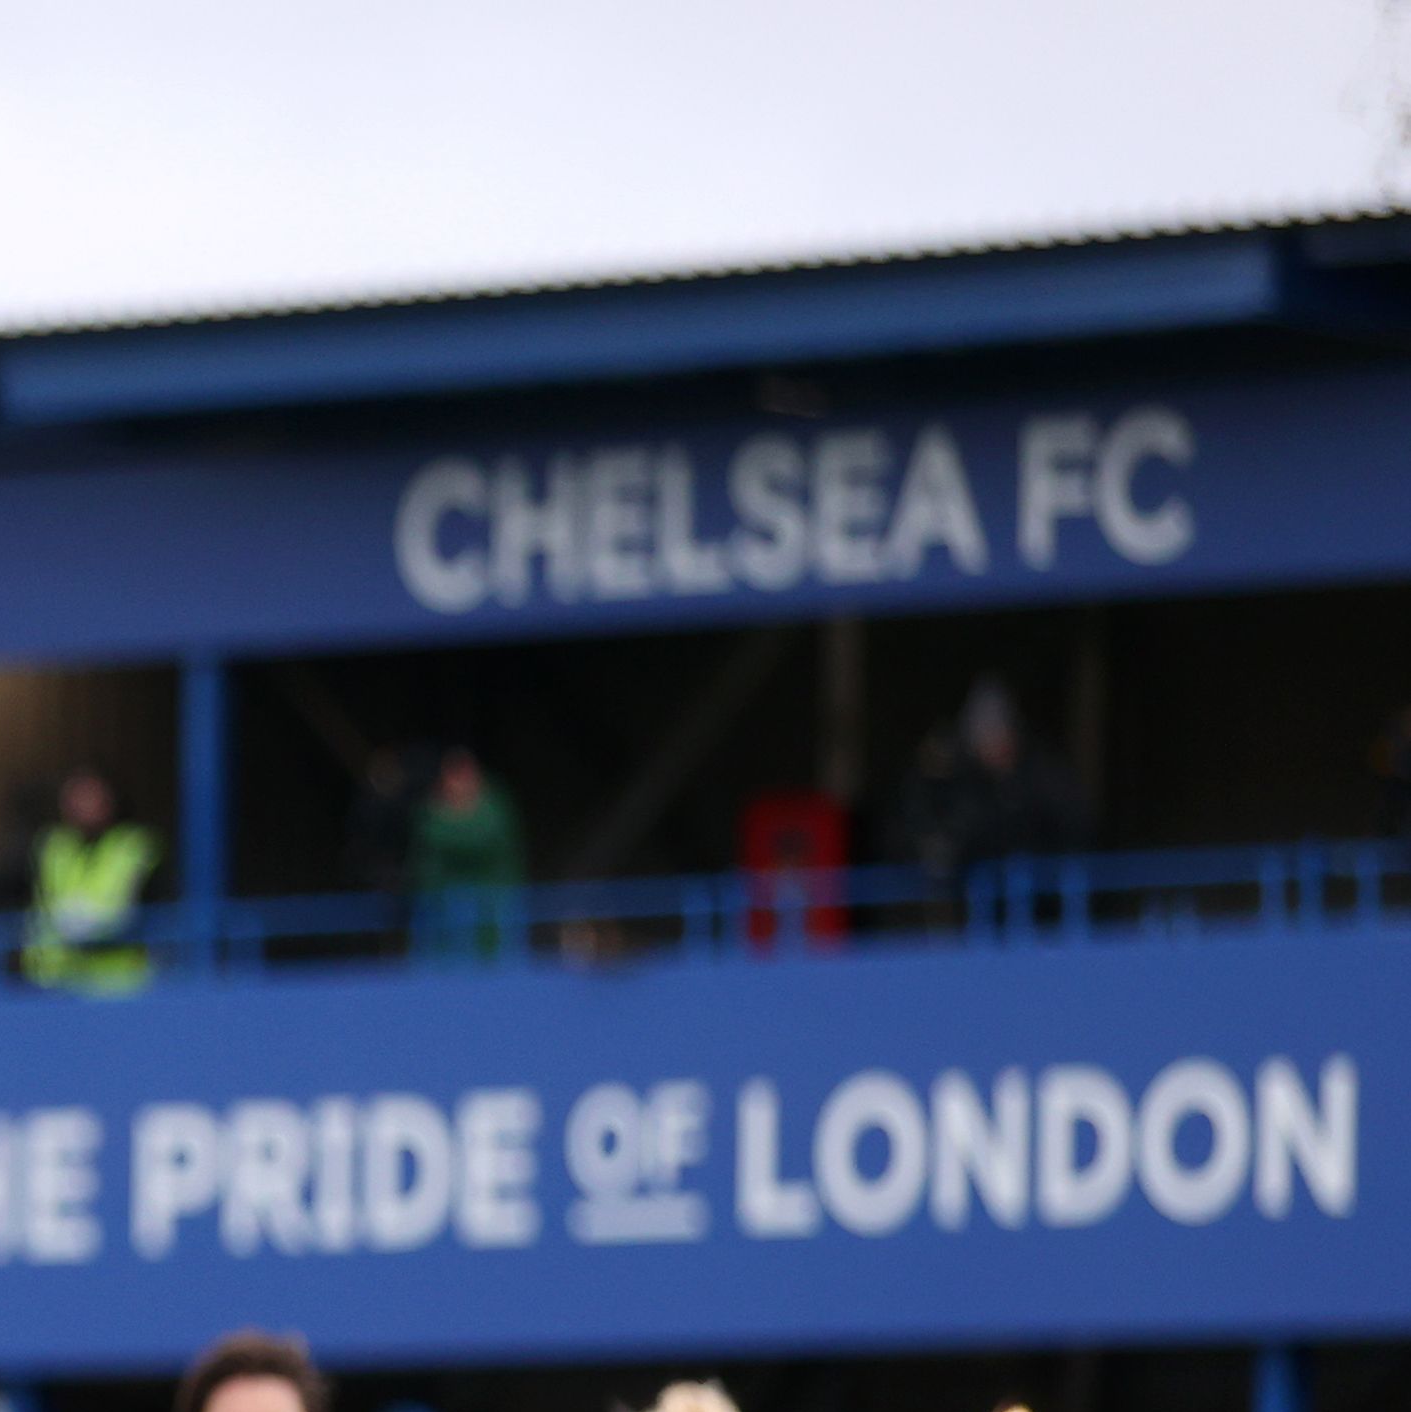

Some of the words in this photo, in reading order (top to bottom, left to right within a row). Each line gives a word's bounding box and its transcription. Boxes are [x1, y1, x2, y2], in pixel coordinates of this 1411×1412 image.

[394, 425, 988, 613] CHELSEA
[1016, 405, 1194, 569] FC
[129, 1086, 543, 1264] PRIDE
[565, 1078, 711, 1199] OF
[735, 1050, 1361, 1240] LONDON
